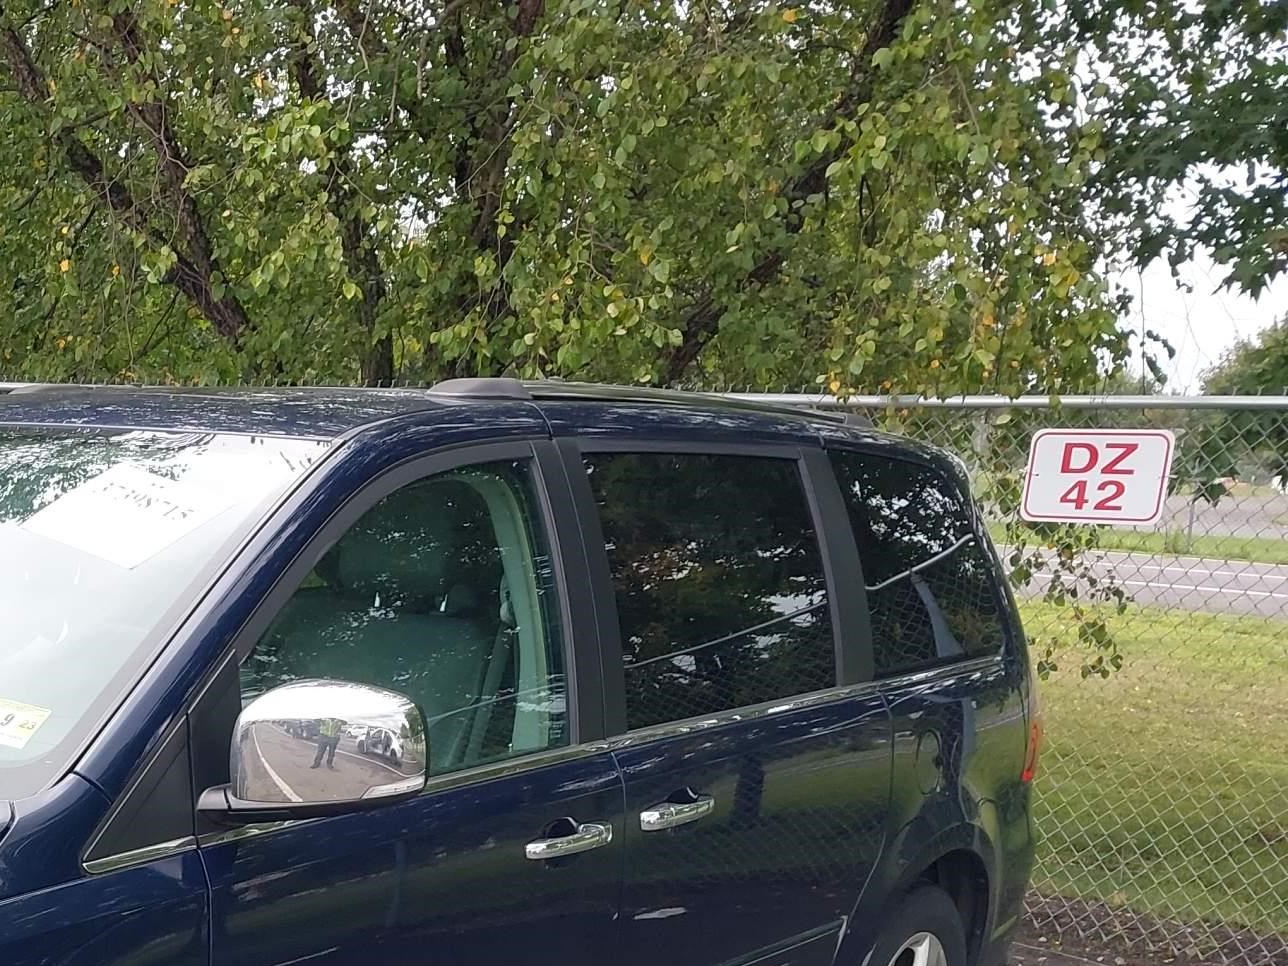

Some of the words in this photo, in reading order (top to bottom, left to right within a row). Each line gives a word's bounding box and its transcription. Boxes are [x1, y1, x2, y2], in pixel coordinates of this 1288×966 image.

[1060, 442, 1139, 475] DZ
[1060, 480, 1126, 511] 42
[0, 713, 16, 727] 9
